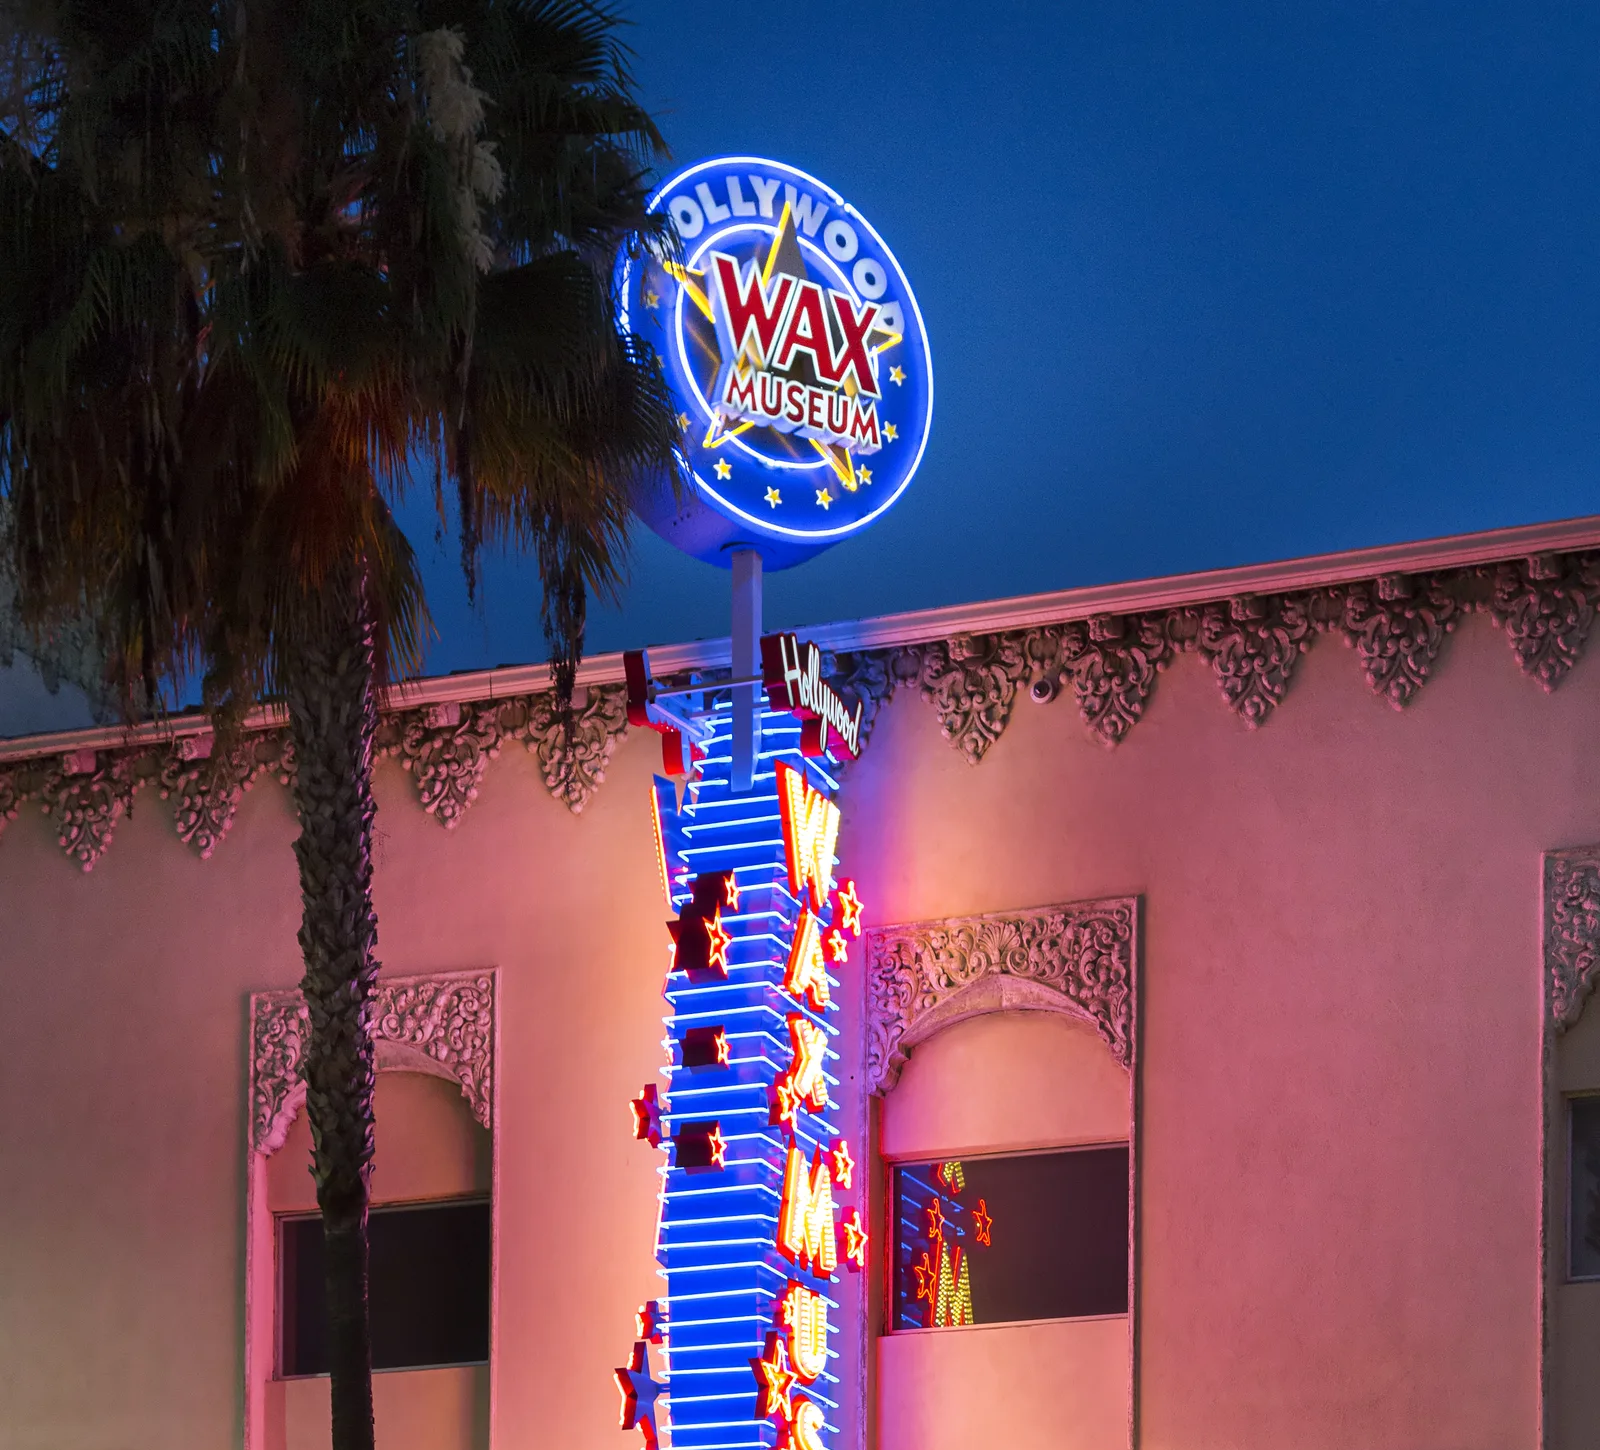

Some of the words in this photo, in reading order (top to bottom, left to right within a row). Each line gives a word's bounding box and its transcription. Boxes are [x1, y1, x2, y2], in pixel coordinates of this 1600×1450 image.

[710, 250, 882, 400] WAX
[724, 362, 882, 450] MUSEUM
[777, 634, 863, 758] Hollywood
[776, 762, 841, 1113] WAX
